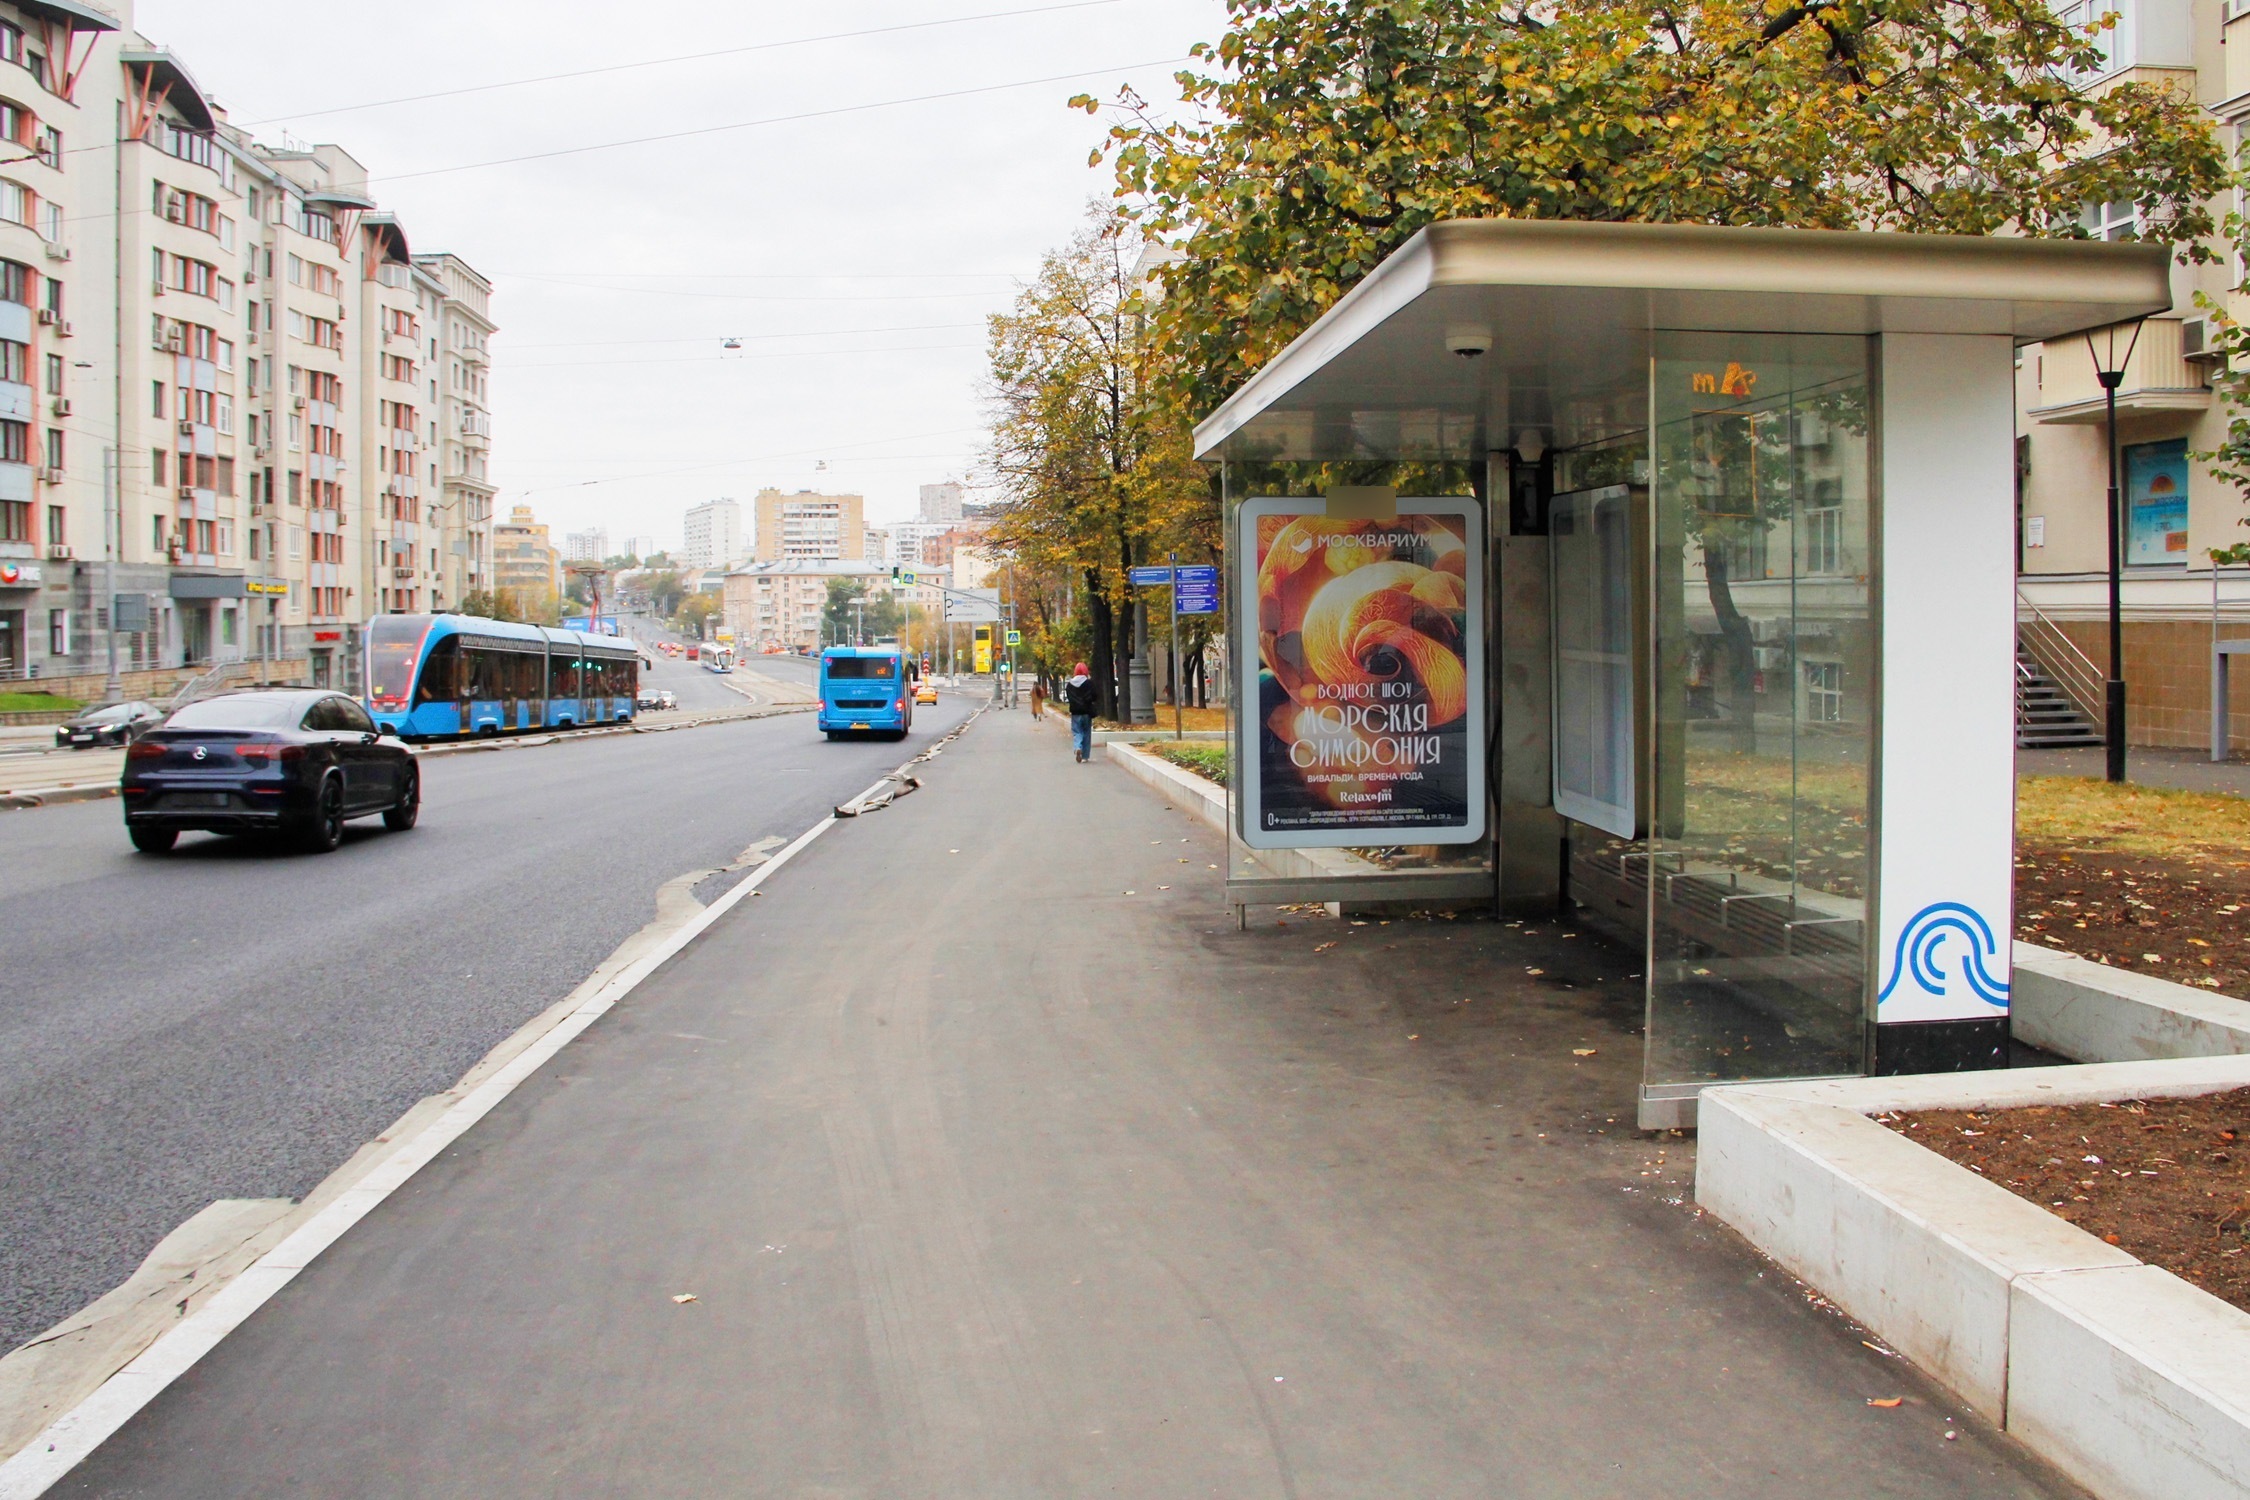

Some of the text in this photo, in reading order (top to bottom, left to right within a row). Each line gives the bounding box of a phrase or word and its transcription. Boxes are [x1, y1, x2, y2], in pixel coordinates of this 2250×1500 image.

[1317, 533, 1432, 548] МОСКВАРИУМ
[1318, 682, 1412, 701] ВОДНОЕ ШОУ
[1302, 703, 1428, 735] МОРСКАЯ
[1289, 736, 1441, 768] СИМФОНИЯ
[1307, 771, 1424, 783] ВИВАЛЬДИ. ВРЕМЕНА ГОДА
[1267, 812, 1280, 826] 0+
